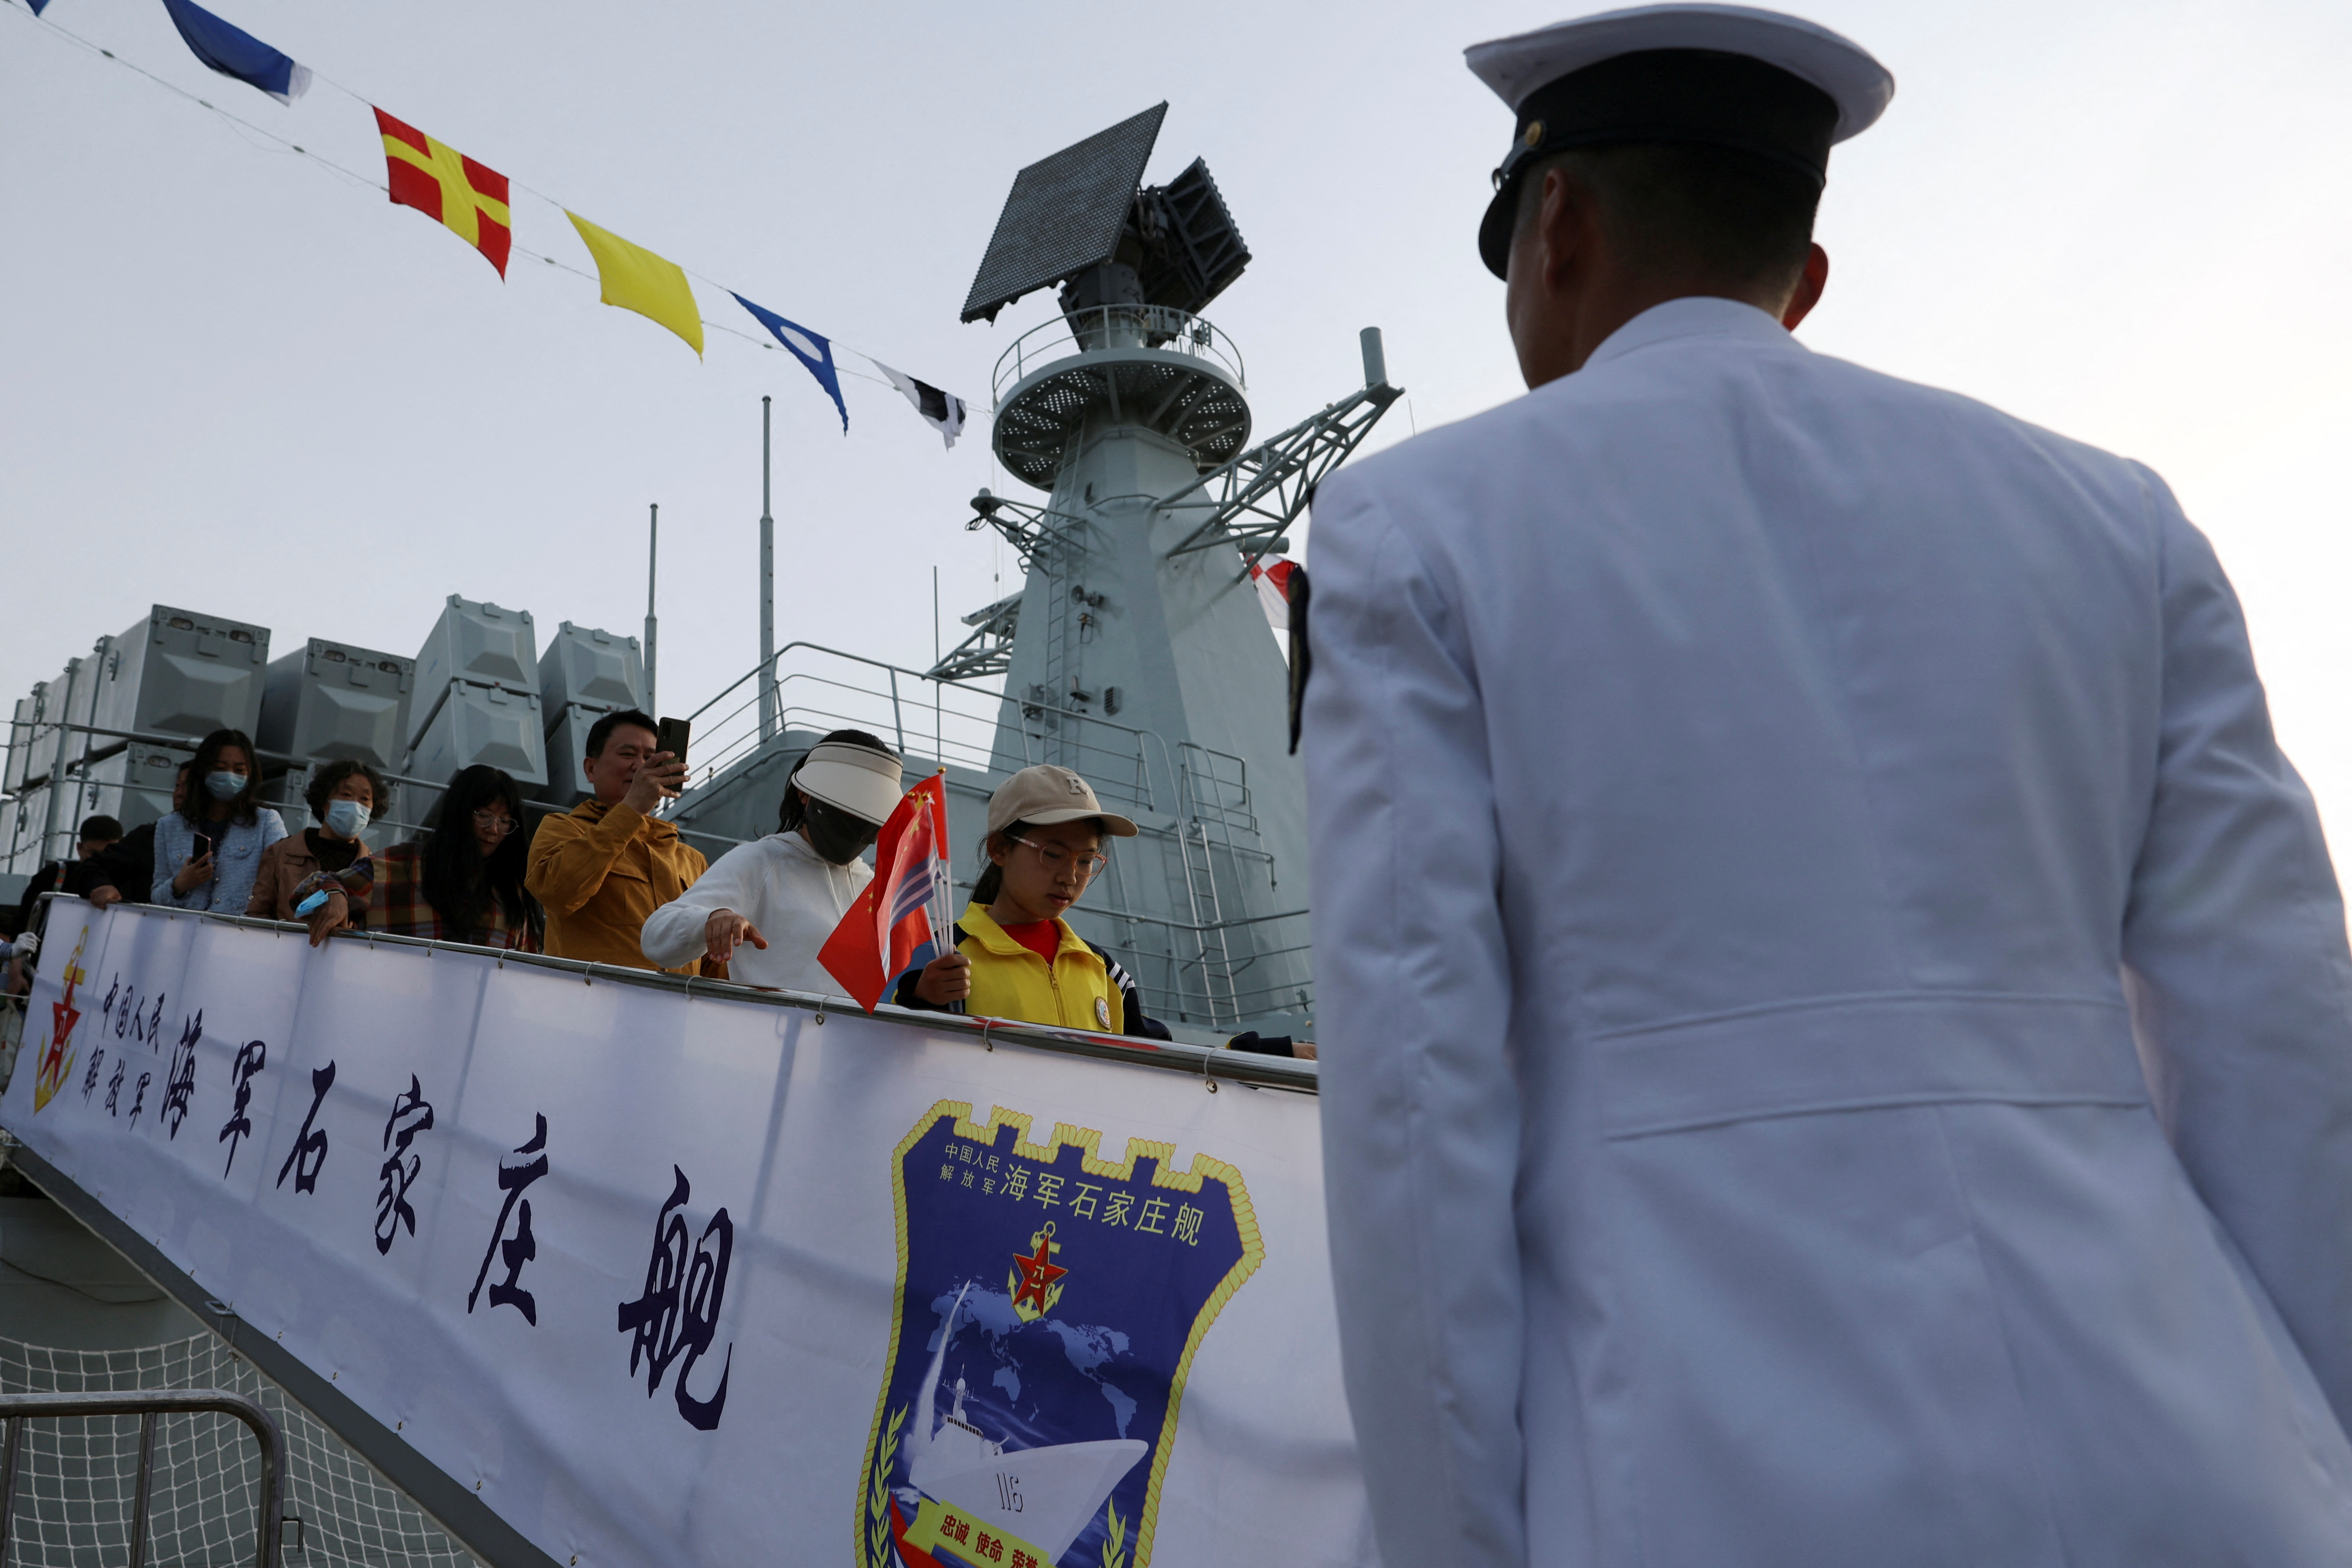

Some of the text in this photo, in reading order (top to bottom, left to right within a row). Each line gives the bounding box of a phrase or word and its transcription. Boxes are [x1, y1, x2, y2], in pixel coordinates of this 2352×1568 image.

[1067, 776, 1087, 794] R
[103, 972, 165, 1055] 中国人民
[82, 1045, 151, 1132] 解放军
[945, 1142, 1000, 1173] 中国人民
[940, 1164, 996, 1195] 解放军
[1000, 1163, 1204, 1246] 海军石家庄舰
[1030, 1265, 1045, 1289] 八一
[996, 1472, 1023, 1513] 116
[939, 1514, 970, 1546] 忠诚
[975, 1531, 1004, 1563] 使命
